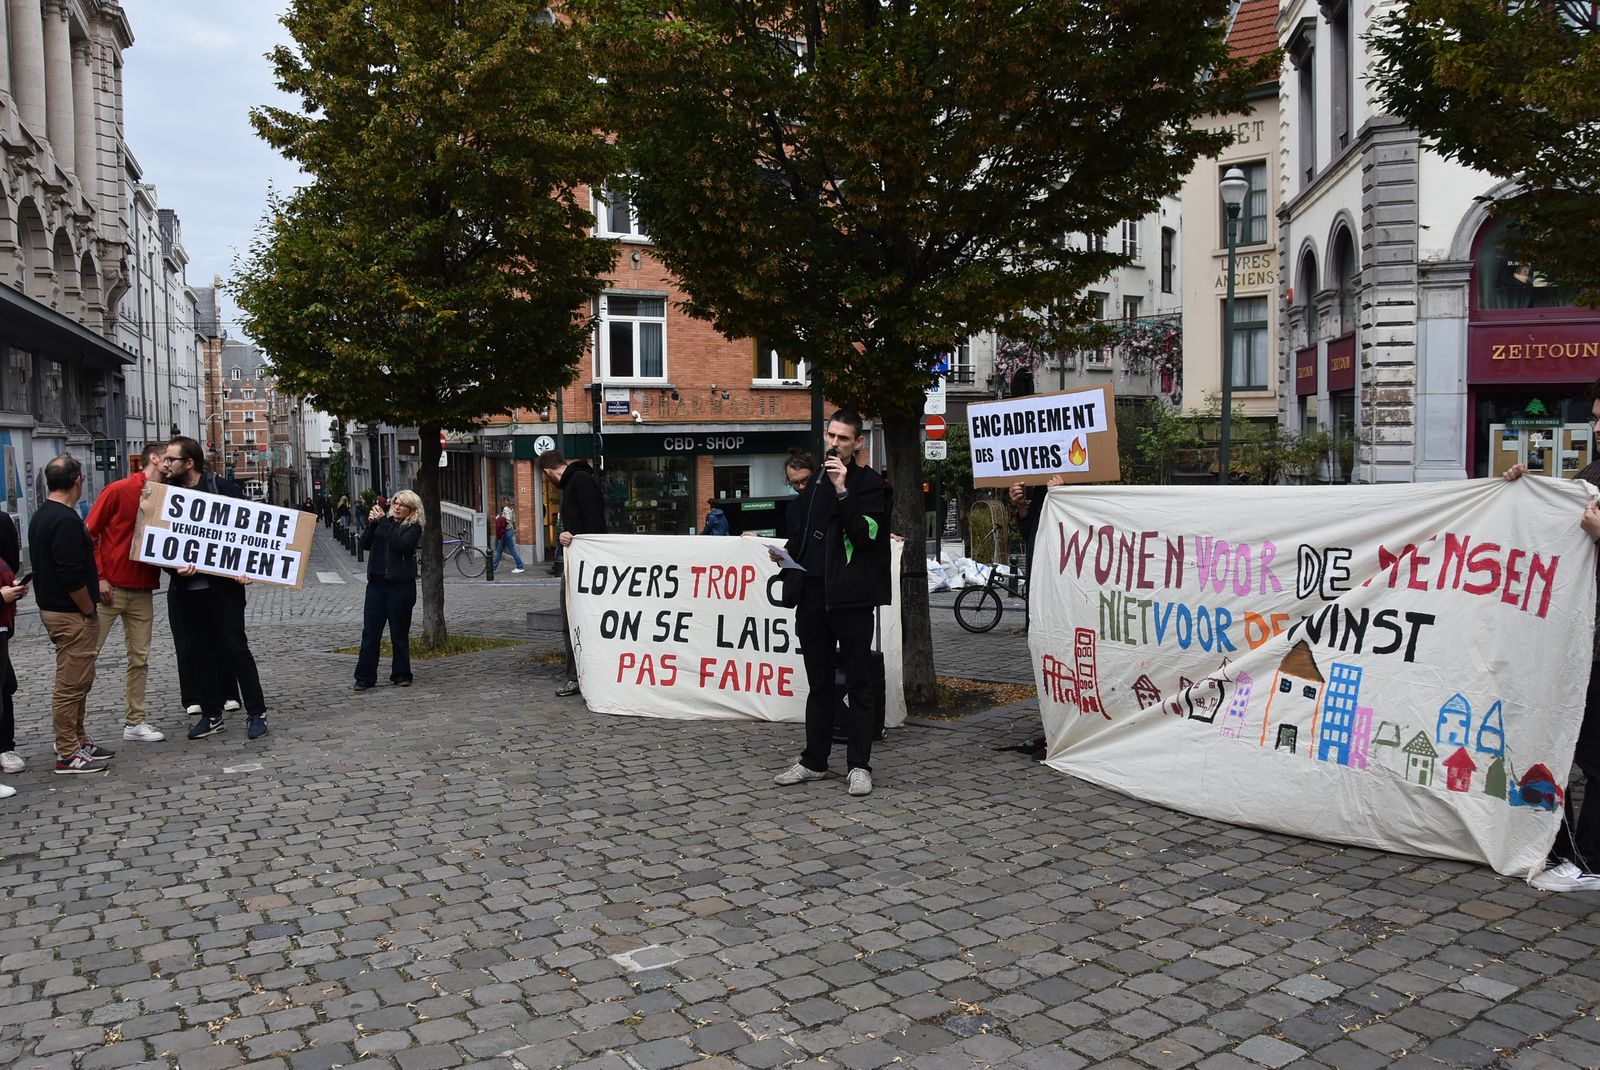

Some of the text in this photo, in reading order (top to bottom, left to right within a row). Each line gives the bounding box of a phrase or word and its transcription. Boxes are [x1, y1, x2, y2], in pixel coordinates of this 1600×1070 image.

[1221, 254, 1270, 271] LVRES
[1492, 342, 1600, 360] ZEITOUN
[972, 403, 1096, 438] ENCADREMENT
[664, 437, 694, 451] CBD
[706, 437, 745, 450] SHOP
[975, 444, 1062, 472] DES LOYERS
[168, 493, 290, 538] SOMBRE
[171, 521, 281, 551] VENDREDI 13 POUR LE
[144, 533, 294, 579] LOGEMENT
[1059, 521, 1560, 619] WONEN VOOR DE MENSEN
[577, 560, 679, 599] LOYERS
[691, 564, 756, 601] TROP
[600, 609, 642, 641] ON
[652, 610, 693, 643] SE
[1099, 591, 1153, 646] NIET
[1153, 602, 1238, 653] VOOR
[1287, 603, 1436, 663] WINST
[616, 652, 794, 697] PAS FAIRE
